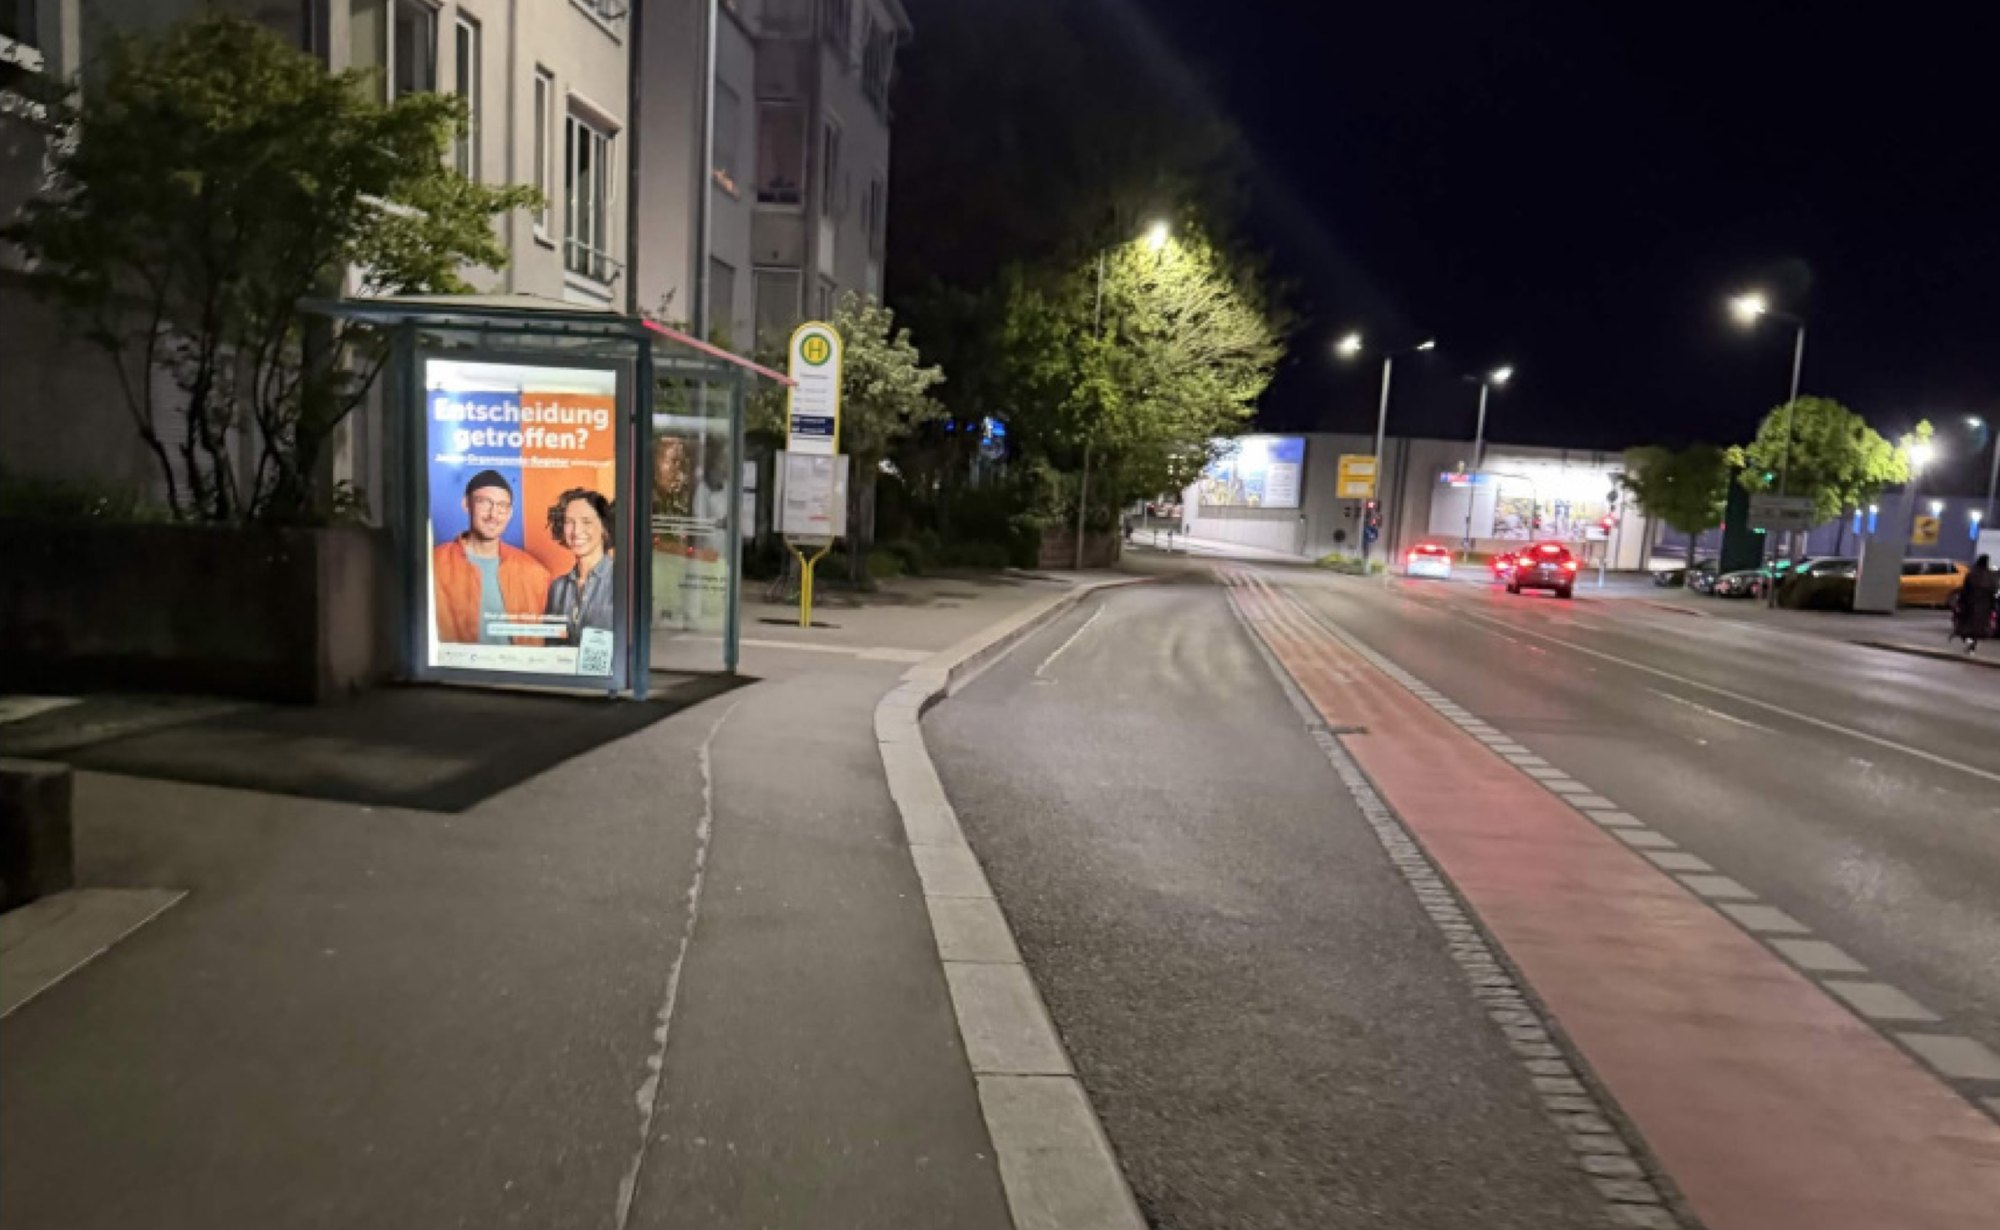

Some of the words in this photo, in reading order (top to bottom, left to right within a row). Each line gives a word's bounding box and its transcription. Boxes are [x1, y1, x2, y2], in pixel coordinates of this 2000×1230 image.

[809, 341, 823, 358] H
[434, 397, 609, 431] Entscheidung
[453, 426, 590, 450] getroffen?
